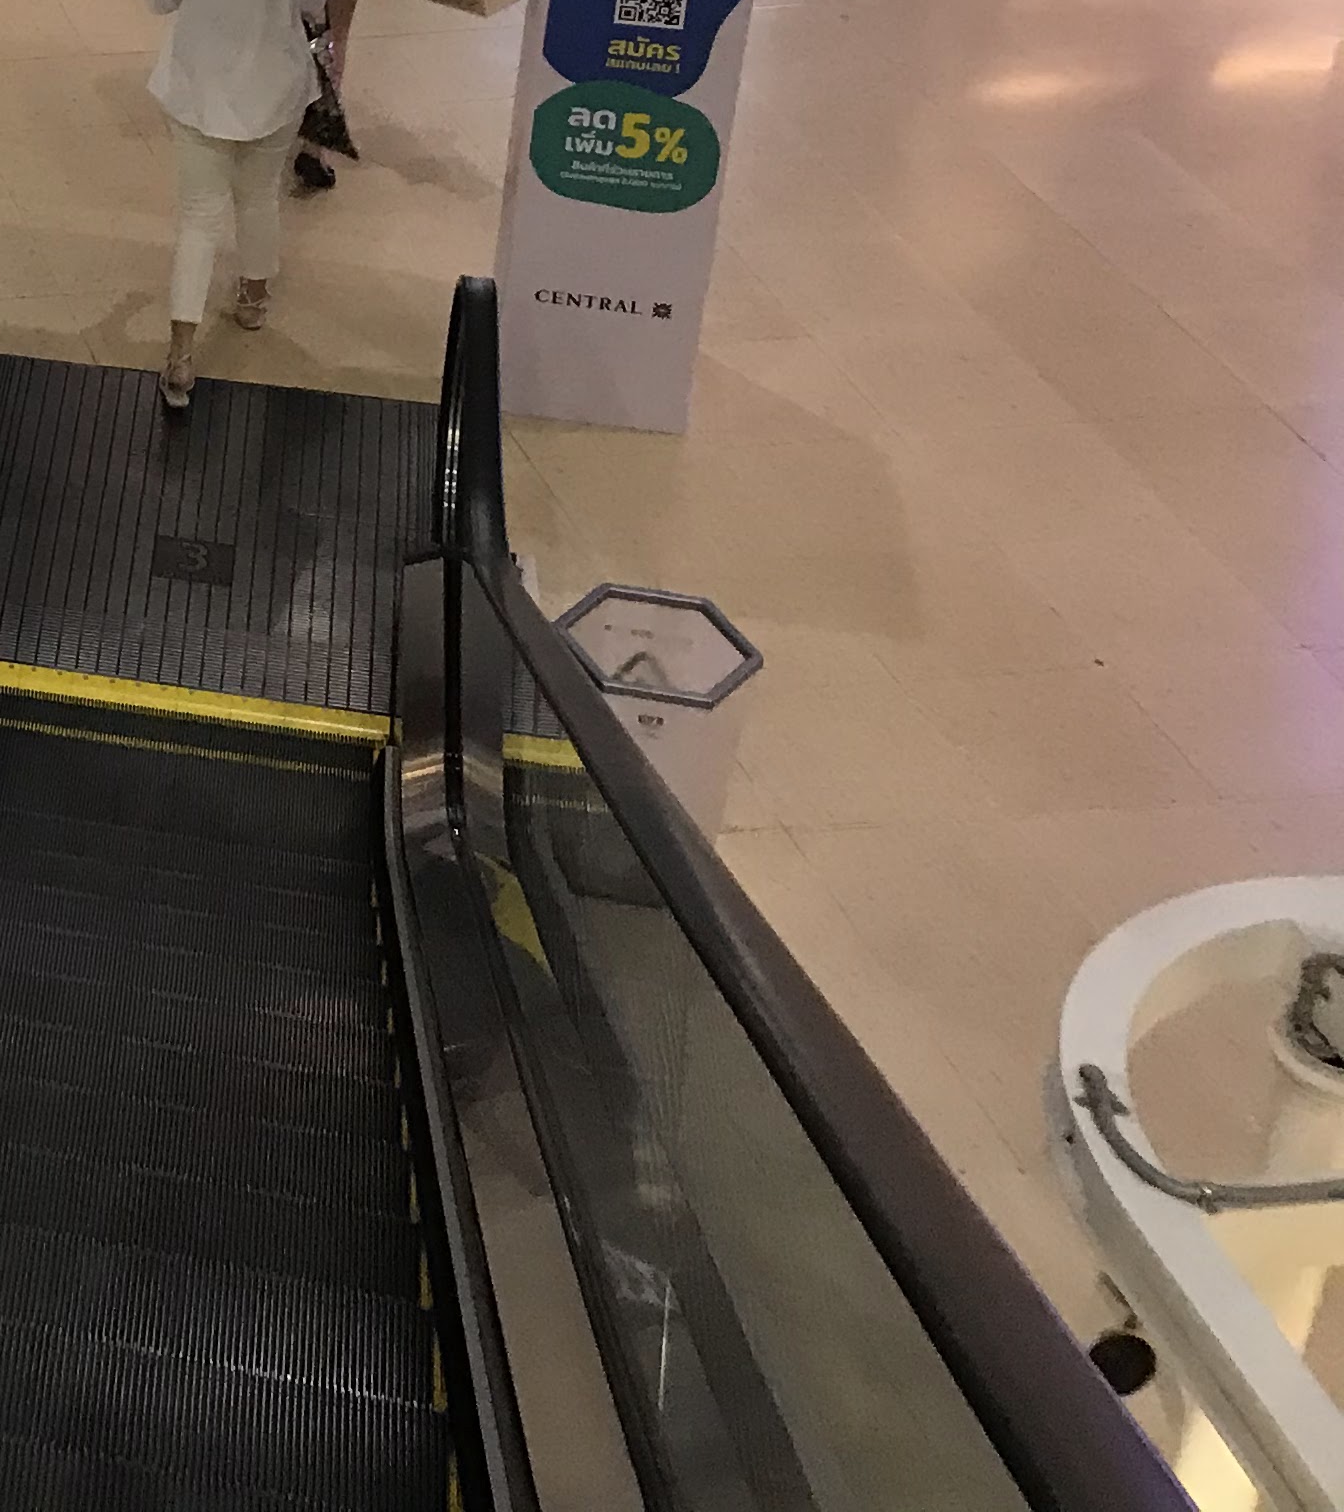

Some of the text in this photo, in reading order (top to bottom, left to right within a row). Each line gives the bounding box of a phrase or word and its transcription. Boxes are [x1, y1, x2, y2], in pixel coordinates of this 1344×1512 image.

[607, 35, 680, 61] สมัคร
[564, 130, 614, 156] เพิ่ม
[567, 106, 688, 165] ลด 5%
[534, 288, 643, 316] CENTRAL
